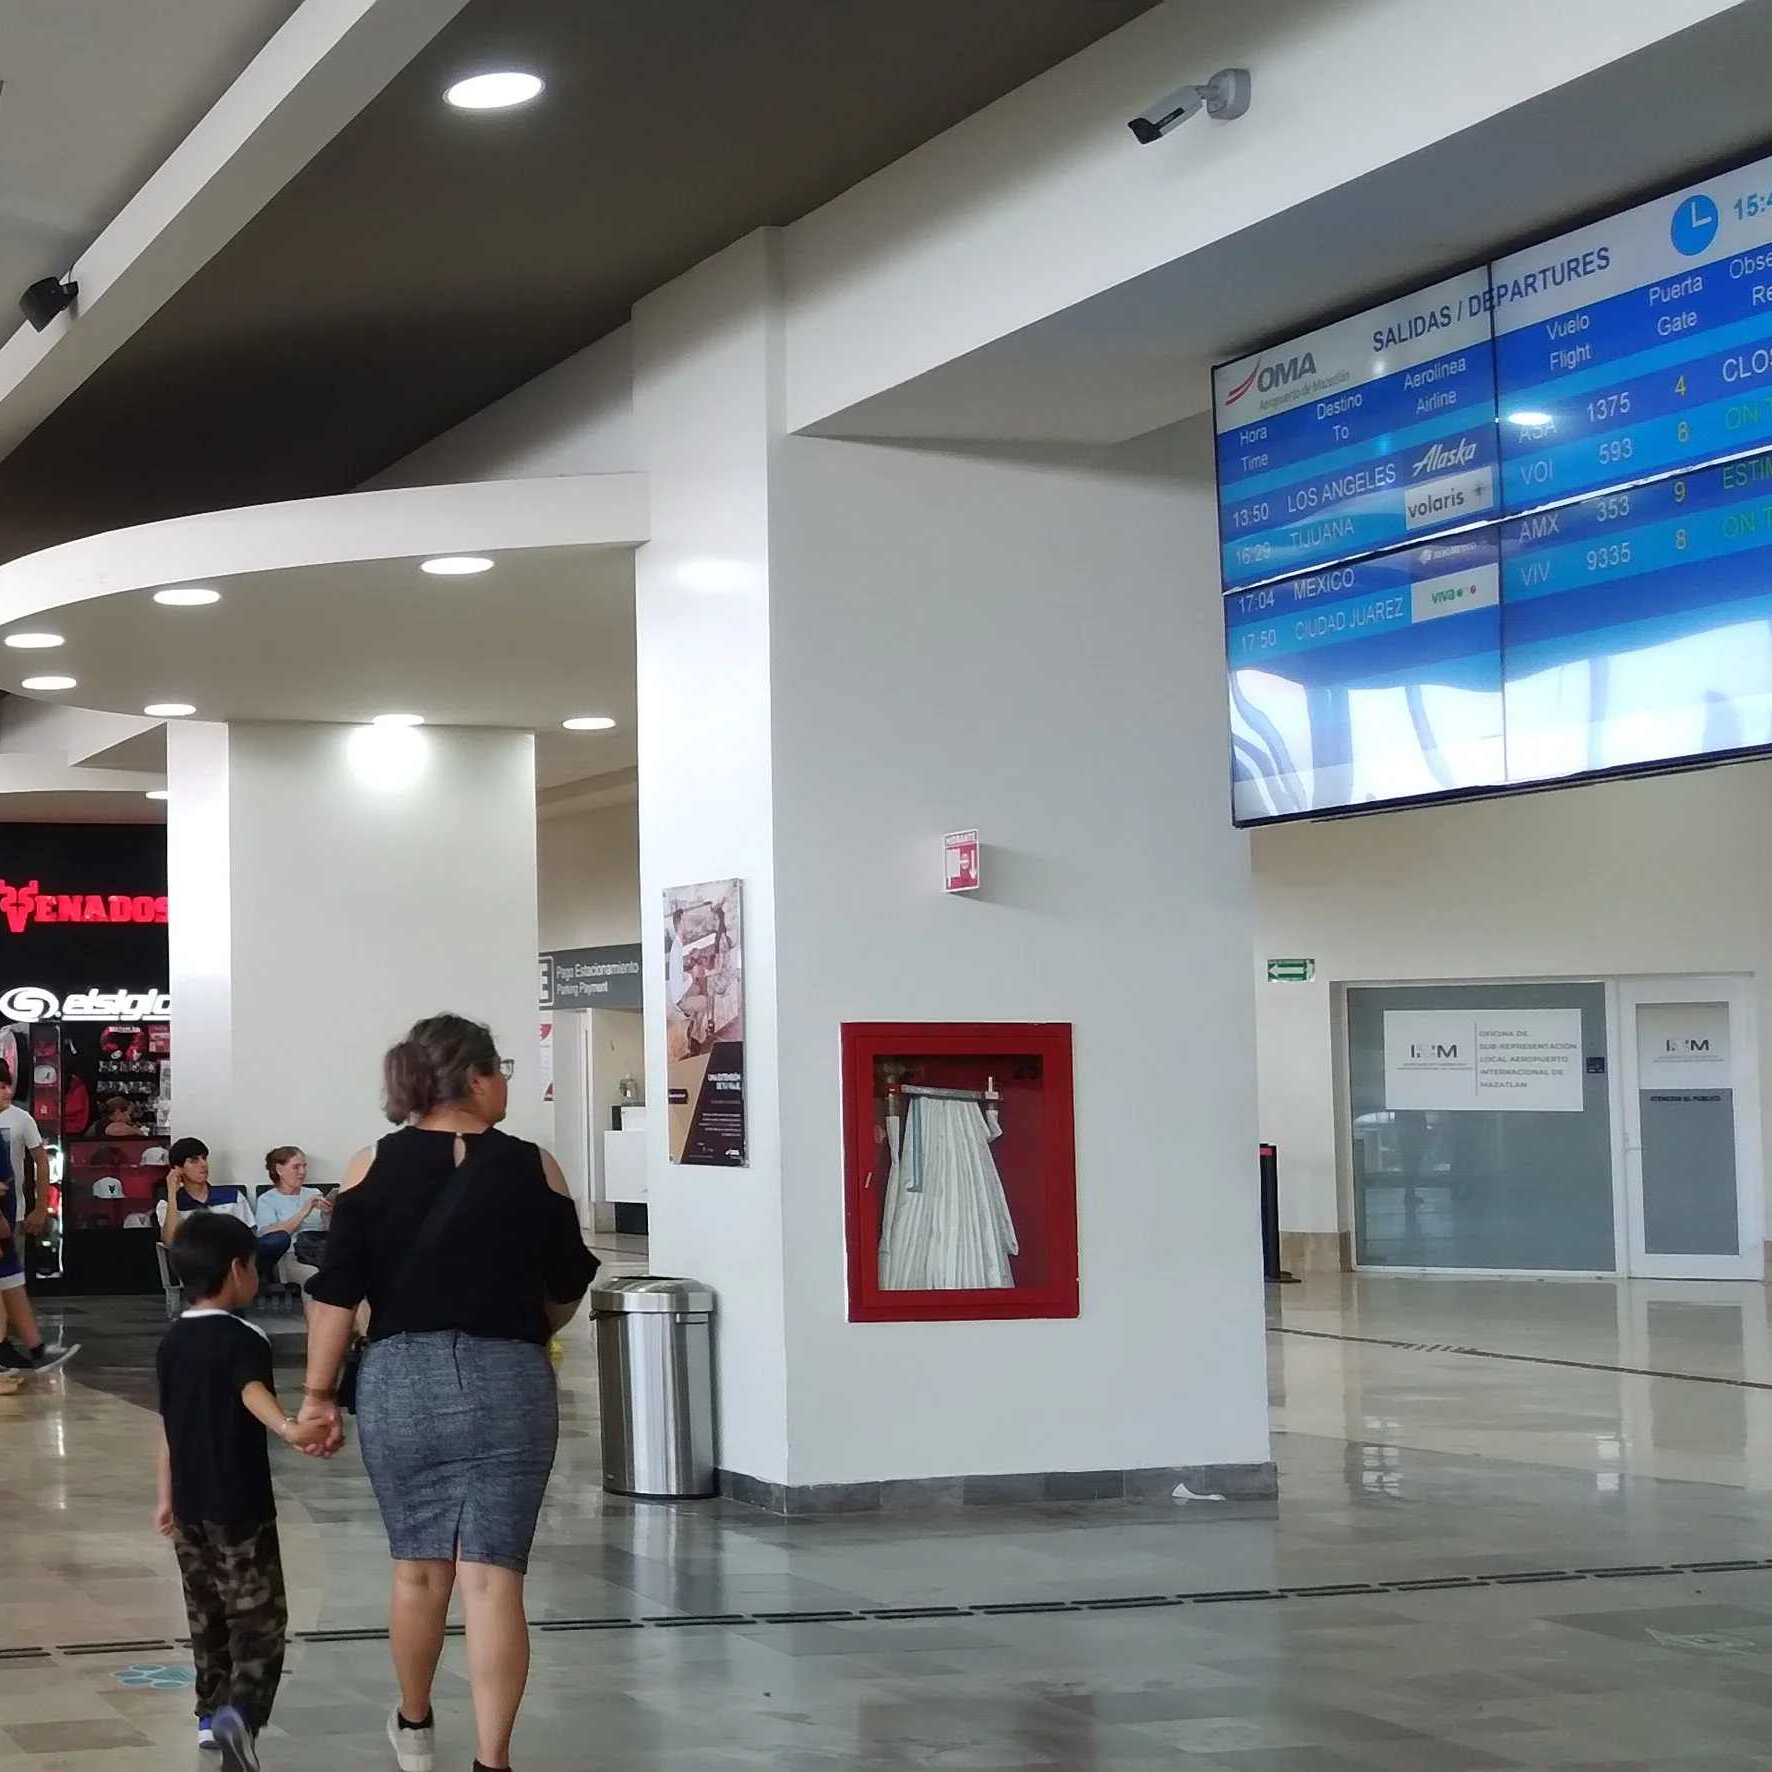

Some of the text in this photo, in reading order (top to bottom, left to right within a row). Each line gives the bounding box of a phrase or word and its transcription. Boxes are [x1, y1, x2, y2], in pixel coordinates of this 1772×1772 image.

[1372, 305, 1452, 352] SALIDAS
[1468, 247, 1610, 318] DEPARTURES
[1240, 426, 1268, 446] Hora
[1316, 393, 1363, 420] Destino
[1546, 314, 1590, 341] Vuelo
[1649, 276, 1703, 307] Puerta
[1241, 453, 1269, 472] Time
[1333, 425, 1349, 441] To
[1416, 388, 1457, 415] Airline
[1550, 344, 1592, 370] Flight
[1657, 310, 1698, 336] Gate
[1256, 352, 1317, 393] OMA
[1233, 503, 1270, 529] 13:50
[1287, 487, 1318, 513] LOS
[1321, 463, 1397, 499] ANGELES
[1411, 437, 1478, 477] Alaska
[1587, 392, 1631, 422] 1375
[1674, 375, 1687, 396] 4
[1235, 542, 1272, 567] 16:29
[1289, 517, 1355, 549] TIJUANA
[1408, 487, 1465, 520] volaris
[1521, 460, 1553, 484] VOI
[1599, 438, 1632, 465] 593
[1725, 403, 1759, 430] ON
[1239, 591, 1275, 614] 17:04
[1293, 568, 1355, 600] MEXICO
[1519, 513, 1560, 543] AMX
[1596, 495, 1630, 522] 353
[1673, 481, 1686, 502] 9
[1241, 629, 1277, 654] 17:50
[1295, 612, 1346, 640] CIUDAD
[1349, 597, 1404, 628] JUAREZ
[1521, 561, 1551, 586] VIV
[1587, 542, 1631, 571] 9335
[1675, 528, 1687, 549] 8
[1723, 514, 1755, 538] ON
[556, 966, 574, 981] Pago
[575, 960, 639, 978] Estacionamiento
[579, 981, 609, 996] Payment
[1479, 1030, 1529, 1038] OFICINA DE
[1480, 1068, 1564, 1076] INTERNACIONAL DE
